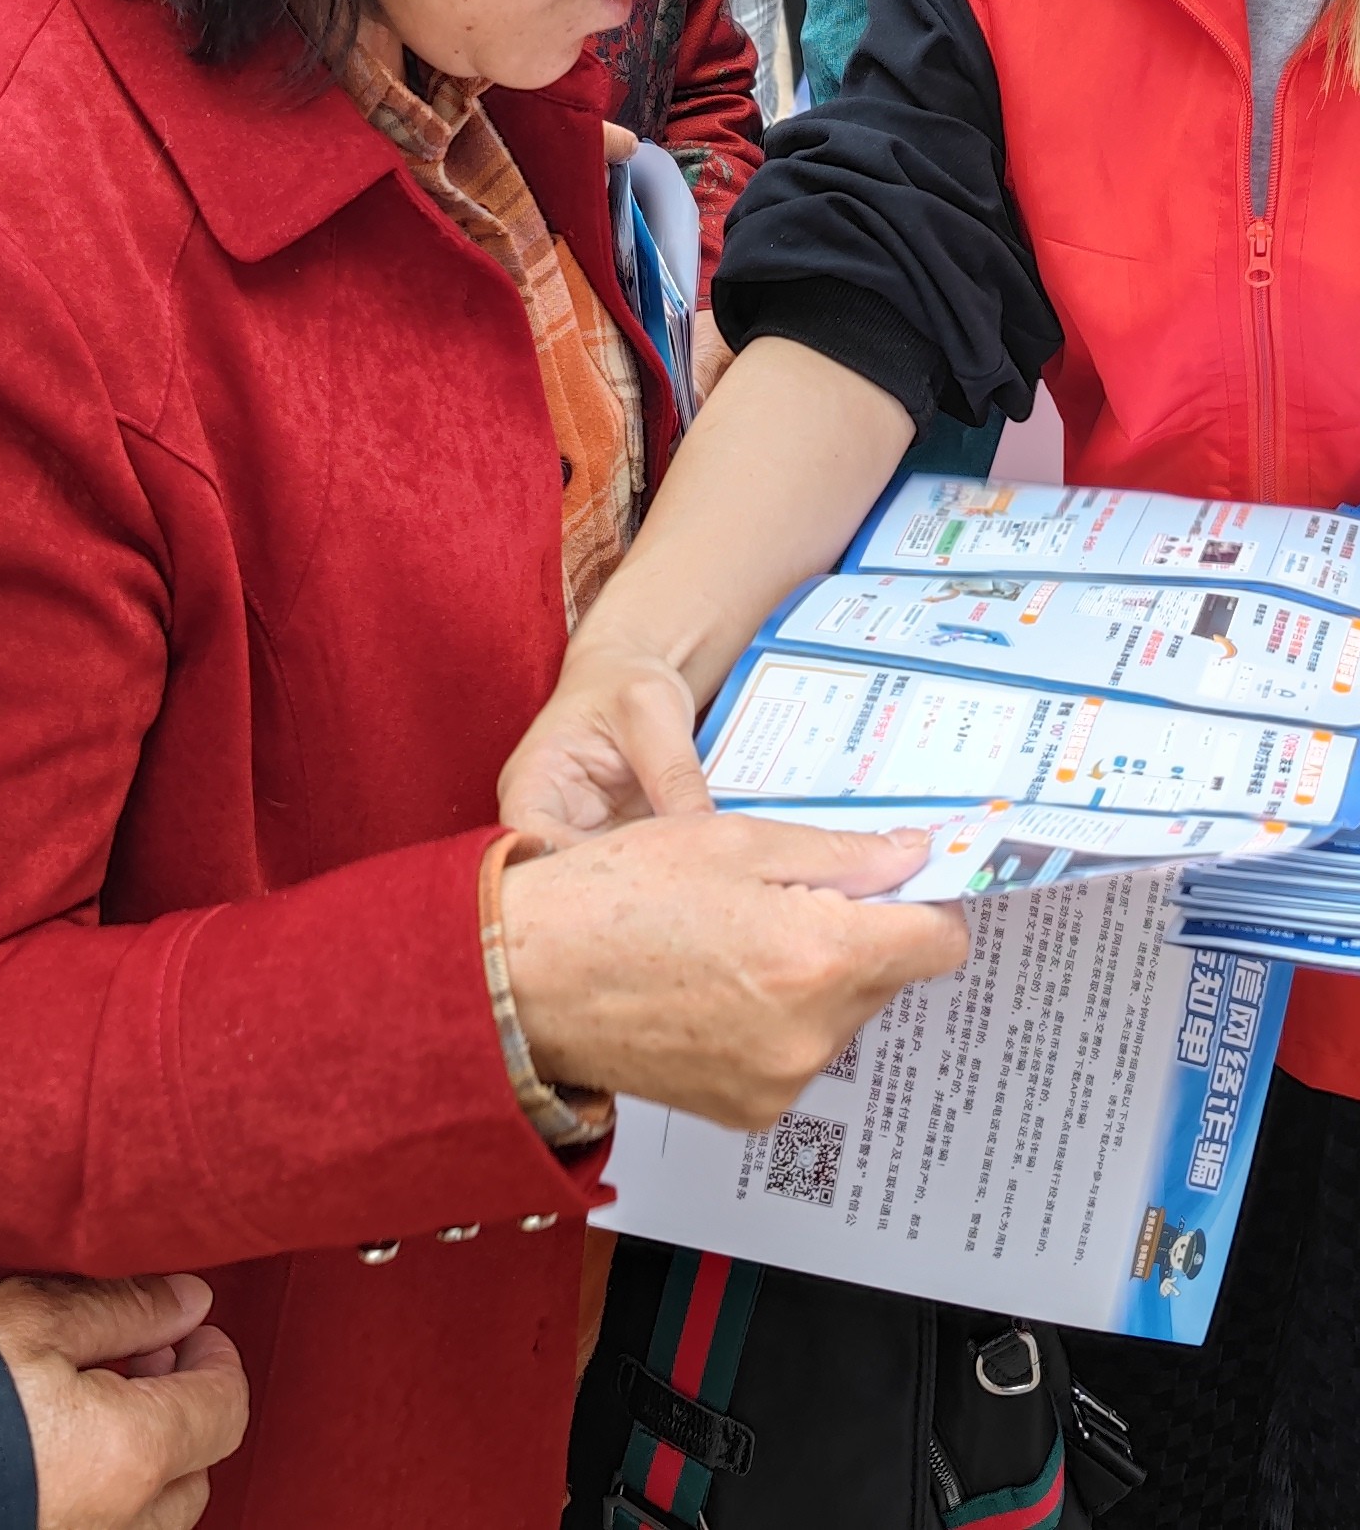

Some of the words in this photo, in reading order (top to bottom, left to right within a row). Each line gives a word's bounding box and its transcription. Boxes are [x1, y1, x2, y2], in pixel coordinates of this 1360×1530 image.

[877, 979, 915, 1139] 活动的，将承担法律责任！
[963, 887, 1043, 1253] 信群文字指令汇款的，务必要向老板电话或当面核实，警惕是
[1013, 884, 1059, 1077] 的（图片都是PS的），都是诈骗！
[1023, 879, 1090, 1174] 线，介绍参与区块链、虚拟币等投资的，都是诈骗！
[1186, 955, 1268, 1193] 信网络诈骗
